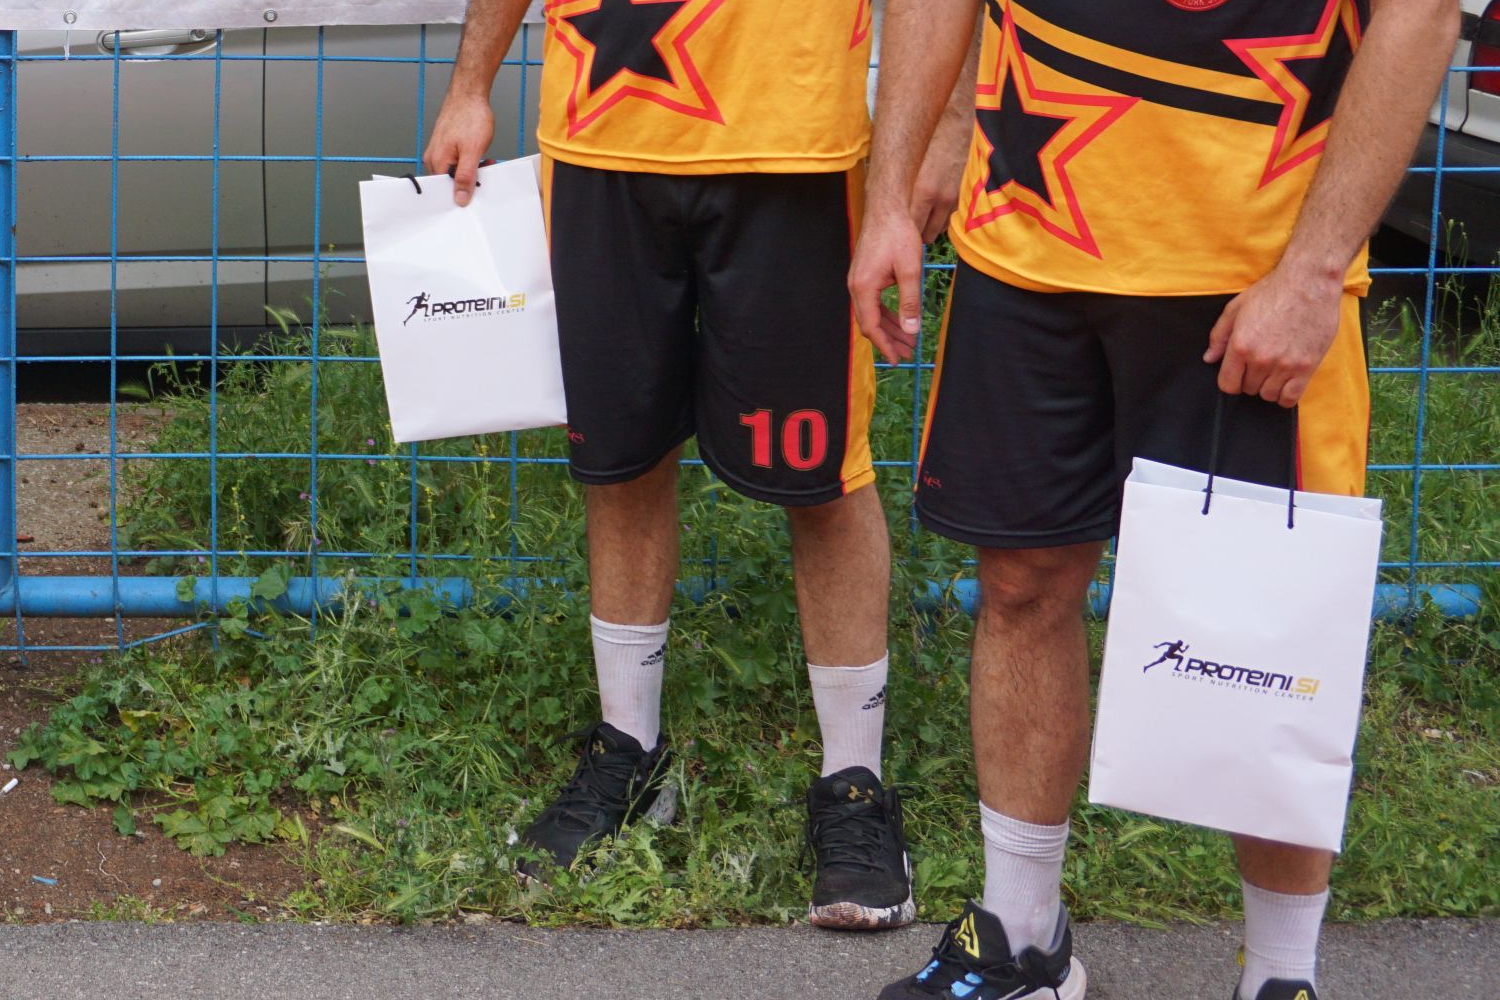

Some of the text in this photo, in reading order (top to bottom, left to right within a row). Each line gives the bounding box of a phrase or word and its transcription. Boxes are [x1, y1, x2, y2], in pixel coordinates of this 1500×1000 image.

[739, 408, 828, 472] 10
[1171, 671, 1315, 702] SPORT NUTRITION CENTER
